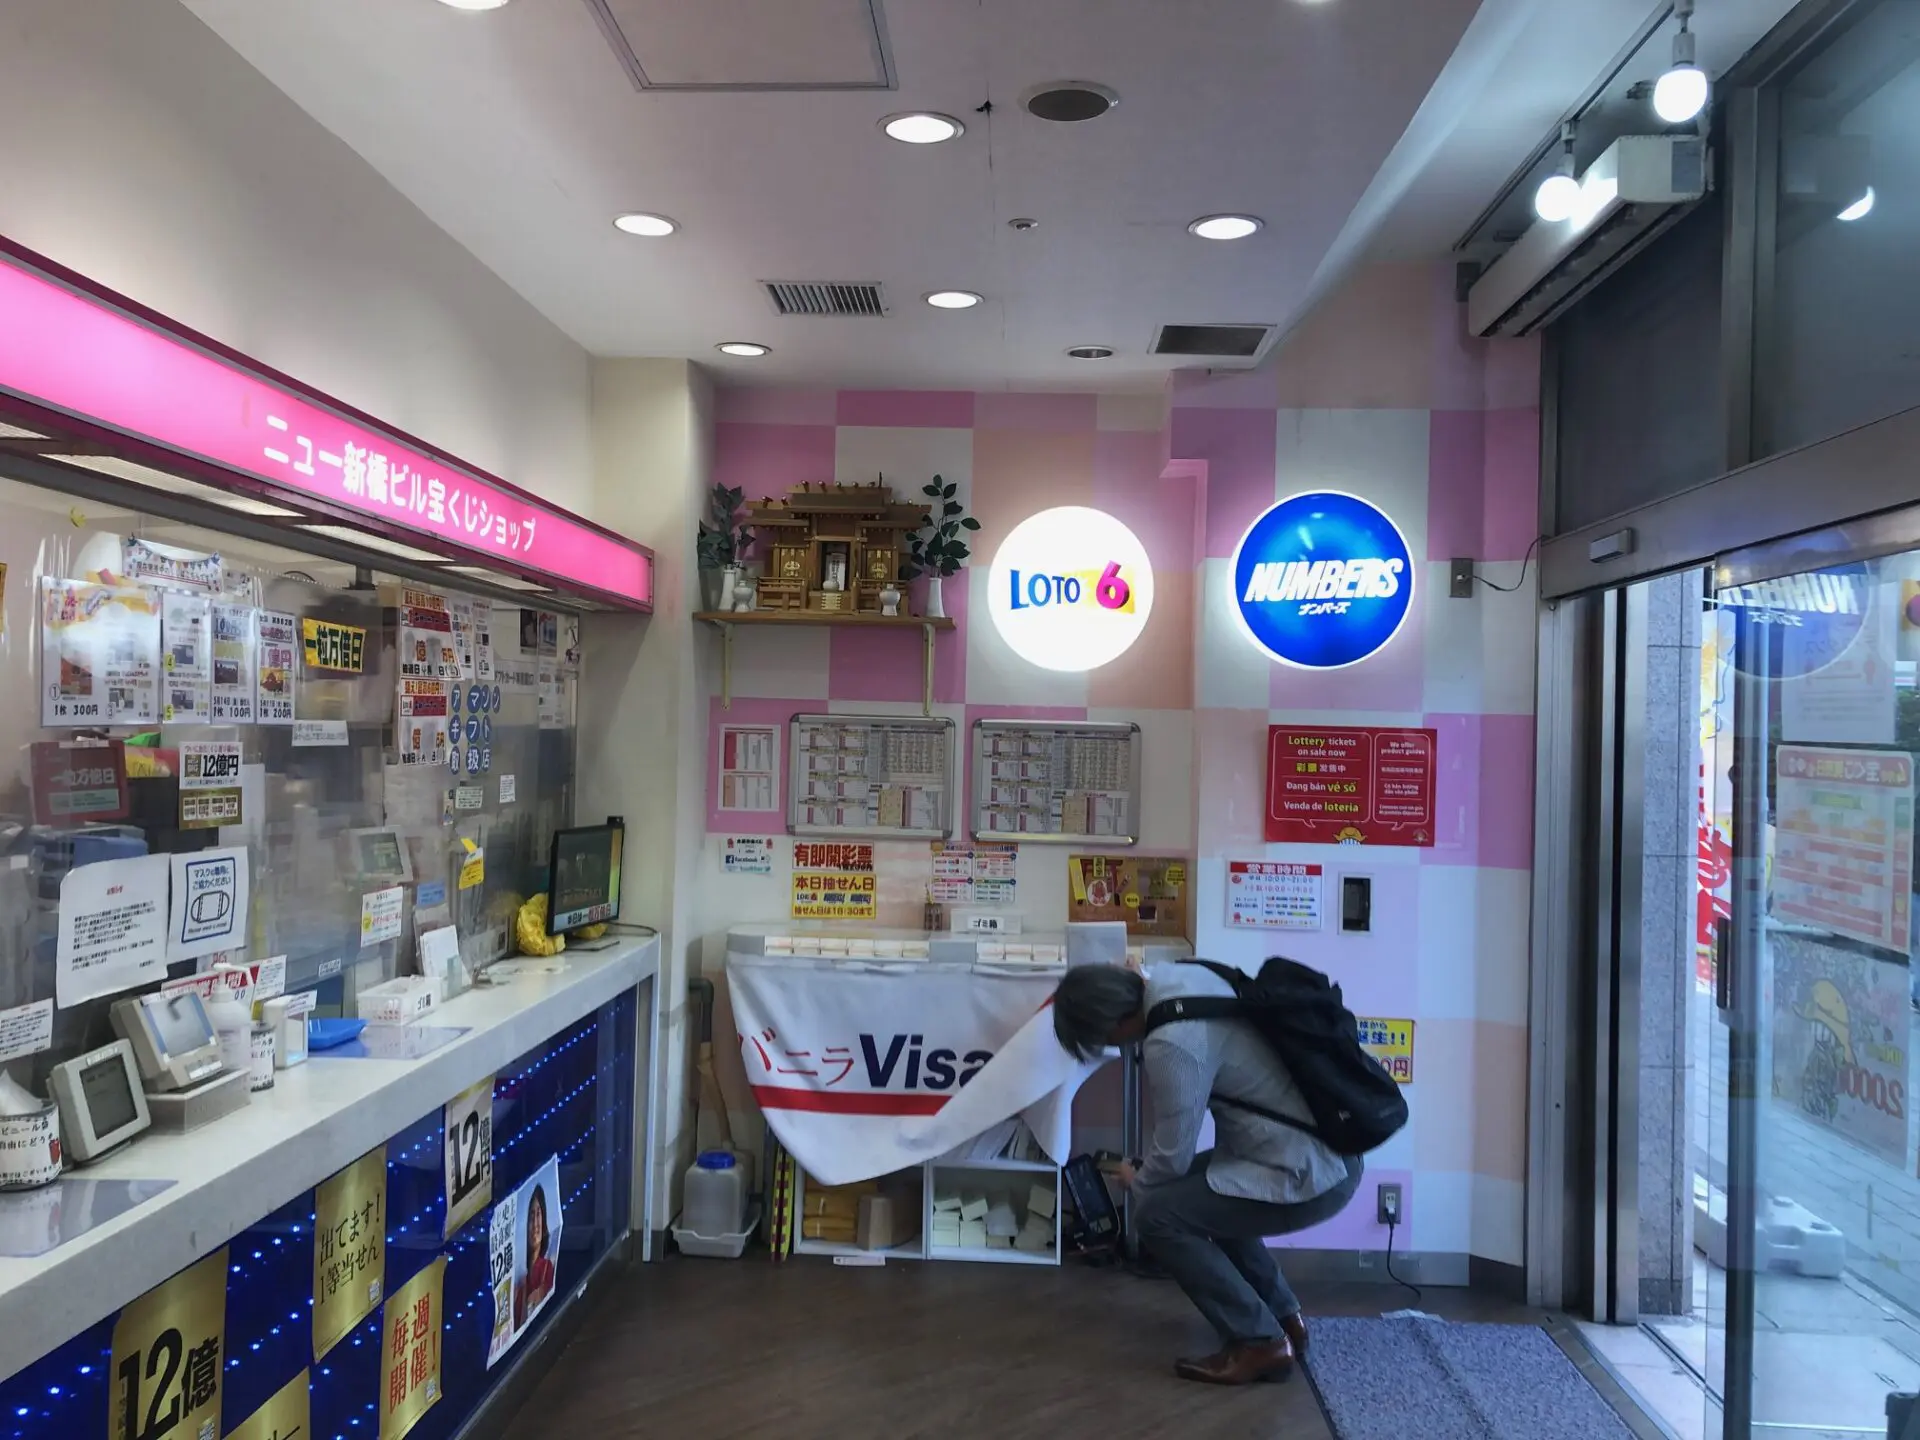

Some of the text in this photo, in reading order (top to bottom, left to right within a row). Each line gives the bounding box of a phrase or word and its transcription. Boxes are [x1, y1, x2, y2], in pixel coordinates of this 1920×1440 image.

[263, 414, 536, 553] ニュー新橋ビル宝くじショップ
[1010, 560, 1131, 610] LOTO 6
[1243, 558, 1404, 603] NUMBERS
[1298, 601, 1352, 616] ナンバーズ
[305, 625, 363, 669] 一粒万倍日
[73, 704, 99, 716] 300円
[229, 707, 251, 718] 100円
[273, 708, 292, 719] 200円
[1288, 736, 1356, 747] Lottery tickets
[1310, 748, 1327, 756] sale
[1328, 749, 1346, 757] now
[203, 754, 239, 778] 12億円
[451, 748, 491, 771] 取扱店
[1284, 802, 1359, 812] Venda de loteria
[795, 876, 874, 891] 本日抽せん日
[1246, 864, 1307, 874] 営業時間
[738, 1026, 994, 1090] バニラ Visa
[319, 1193, 381, 1267] 出てます!
[319, 1235, 380, 1305] 1等当せん
[491, 1243, 514, 1292] 12億
[392, 1291, 431, 1362] 毎週
[118, 1328, 220, 1440] 12億
[389, 1331, 436, 1415] 開催!
